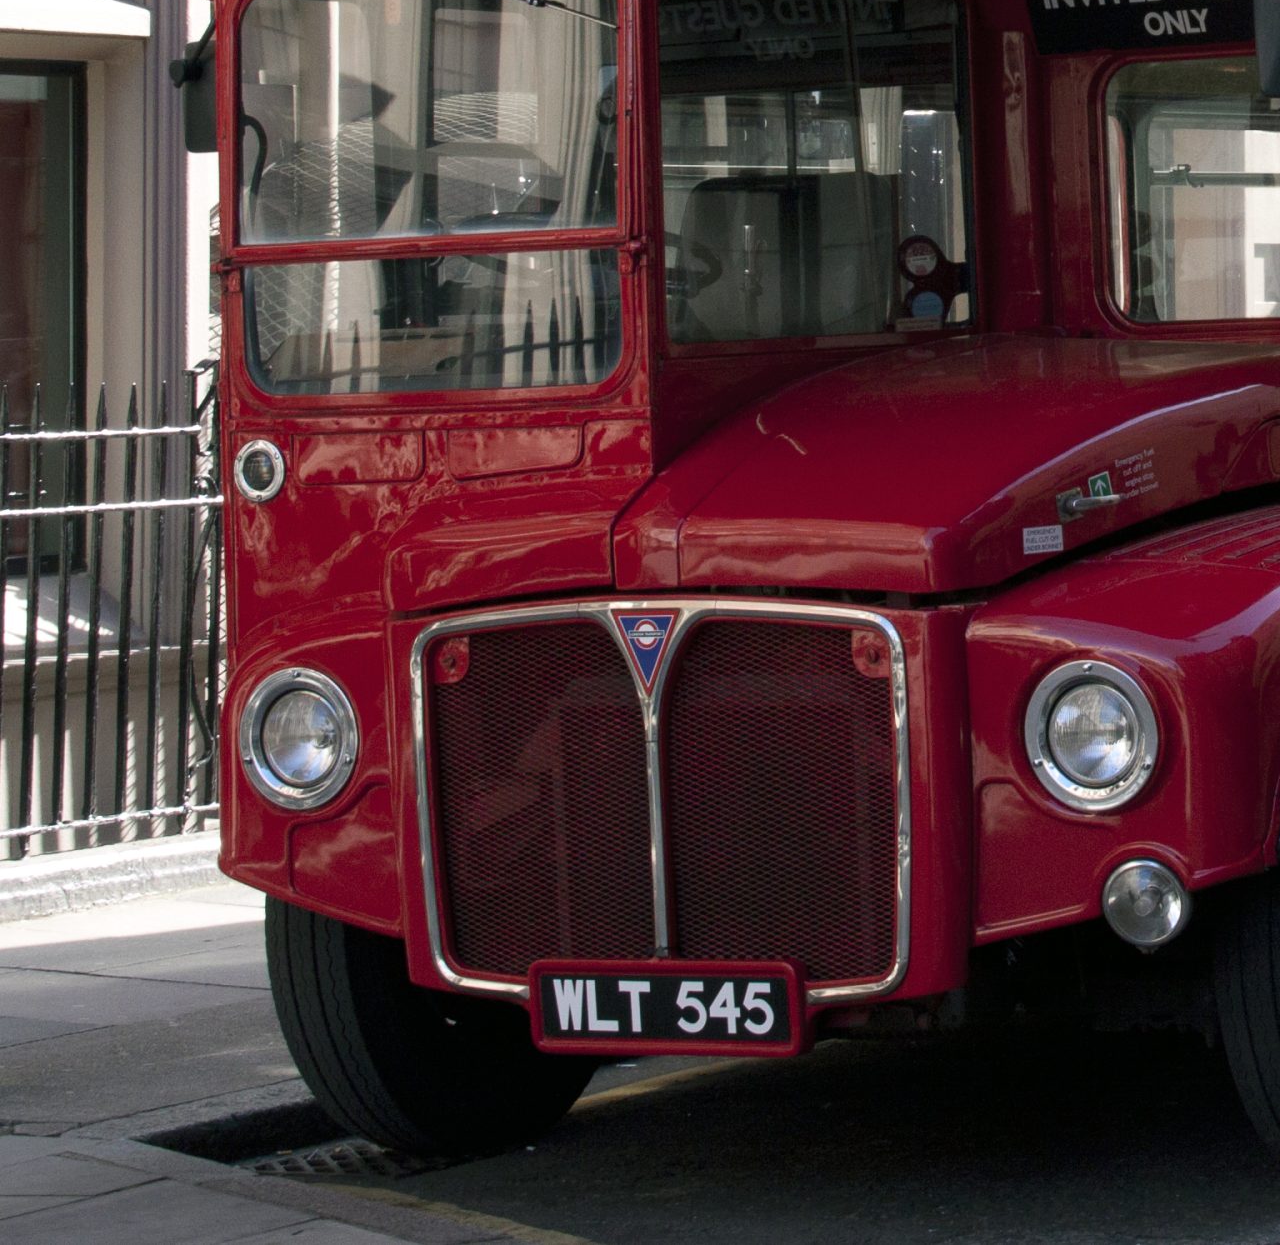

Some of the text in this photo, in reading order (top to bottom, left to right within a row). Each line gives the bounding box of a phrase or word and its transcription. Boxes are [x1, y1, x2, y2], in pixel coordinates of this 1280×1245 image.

[1144, 9, 1209, 36] ONLY
[553, 979, 775, 1035] WLT 545
